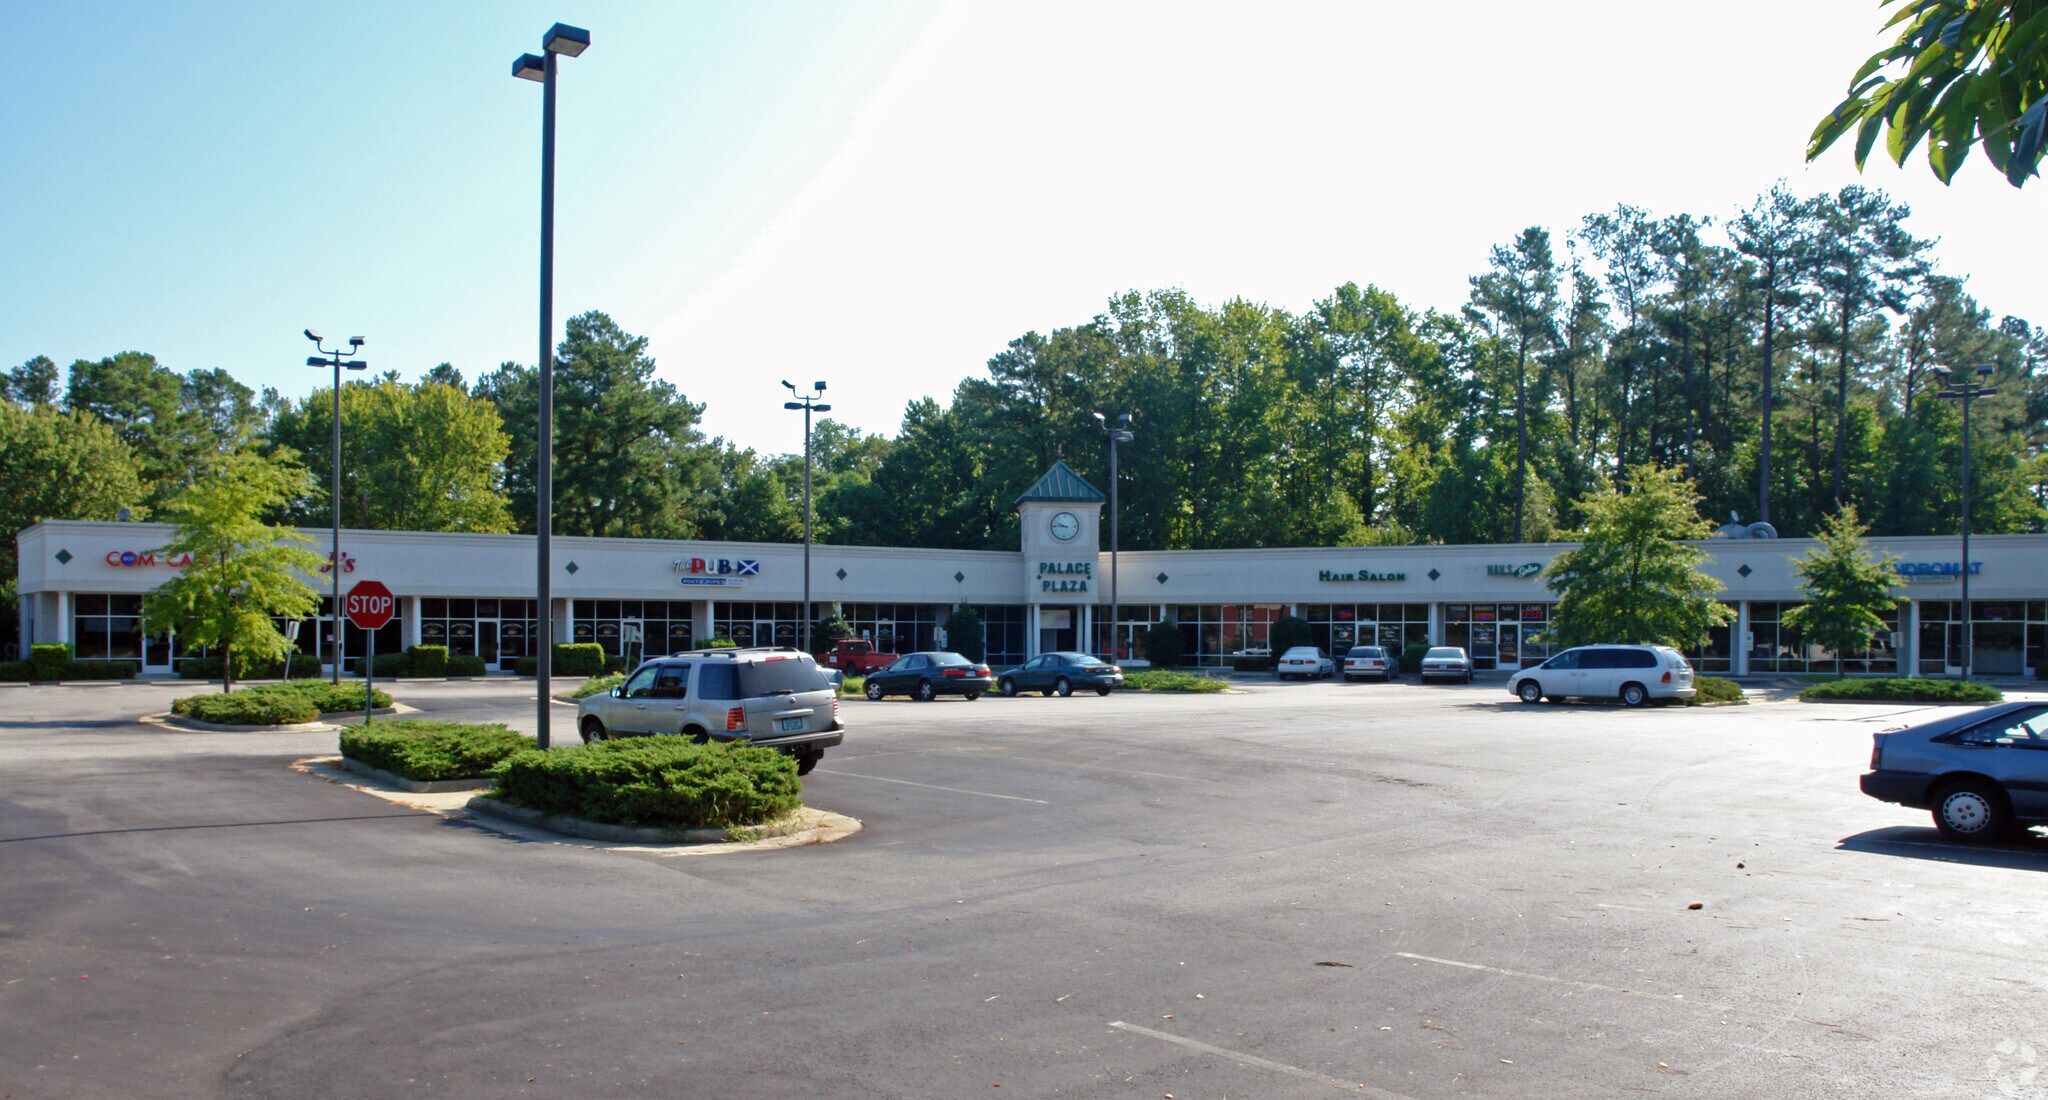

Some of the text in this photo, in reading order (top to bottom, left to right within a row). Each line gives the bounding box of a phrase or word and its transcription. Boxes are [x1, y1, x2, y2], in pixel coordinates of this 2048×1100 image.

[673, 558, 732, 574] The PUB
[1039, 562, 1092, 575] PALACE
[1487, 564, 1514, 577] NAILS
[1319, 569, 1406, 582] HAIR SALON
[1042, 580, 1088, 593] PLAZA
[349, 595, 392, 614] STOP
